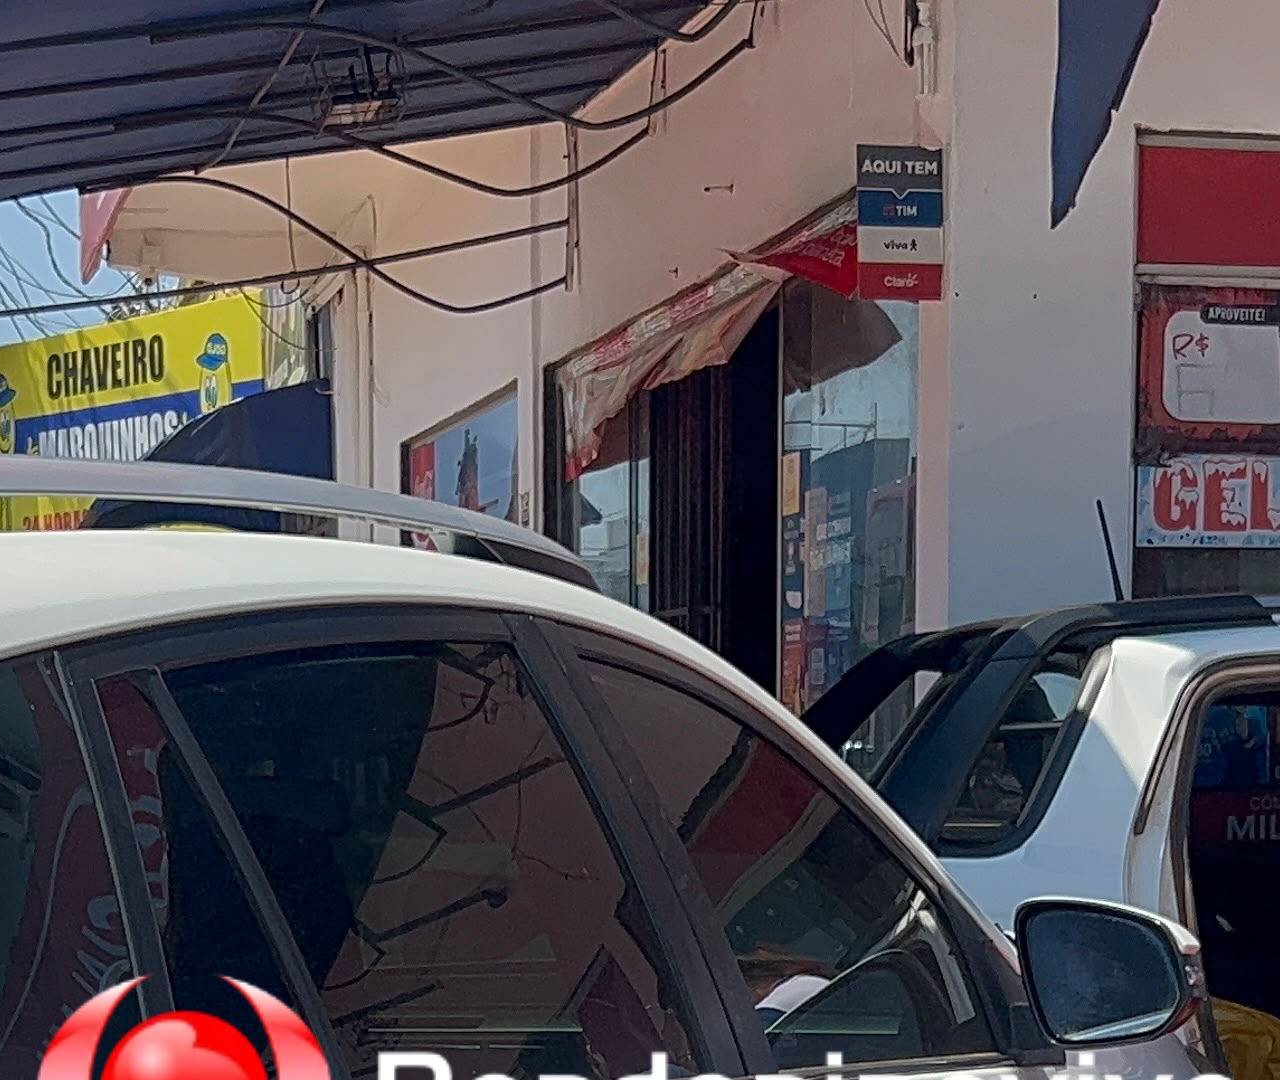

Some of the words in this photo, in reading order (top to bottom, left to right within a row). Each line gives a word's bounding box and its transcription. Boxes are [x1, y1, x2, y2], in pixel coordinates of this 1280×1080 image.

[861, 160, 901, 174] AQUI
[905, 161, 938, 175] TEM
[896, 205, 917, 217] TIM
[1207, 307, 1266, 322] APROVEITE!
[1172, 332, 1210, 361] R$
[46, 334, 165, 401] CHAVEIRO
